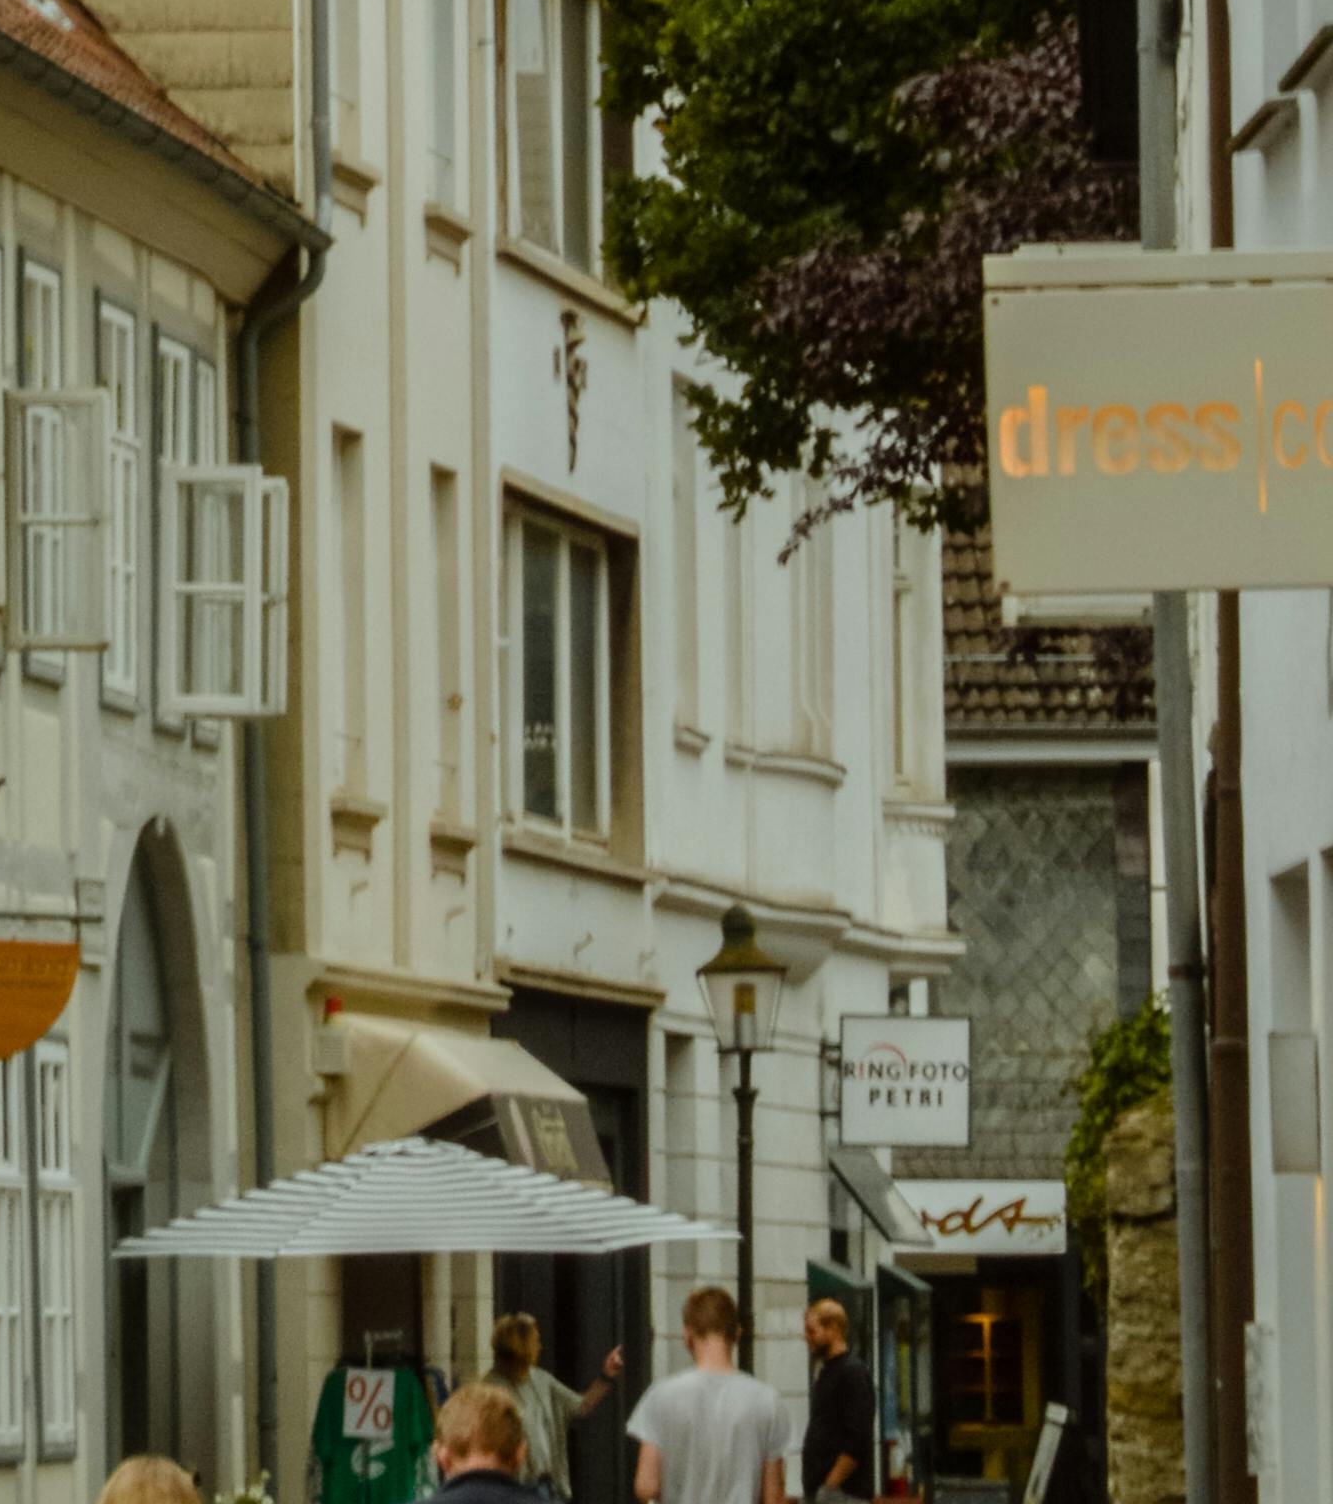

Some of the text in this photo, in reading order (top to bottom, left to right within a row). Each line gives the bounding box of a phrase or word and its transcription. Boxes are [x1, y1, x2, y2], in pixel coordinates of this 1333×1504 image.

[998, 385, 1243, 478] dress
[843, 1060, 967, 1082] RING FOTO
[868, 1087, 944, 1108] PETRI
[347, 1375, 393, 1432] %
